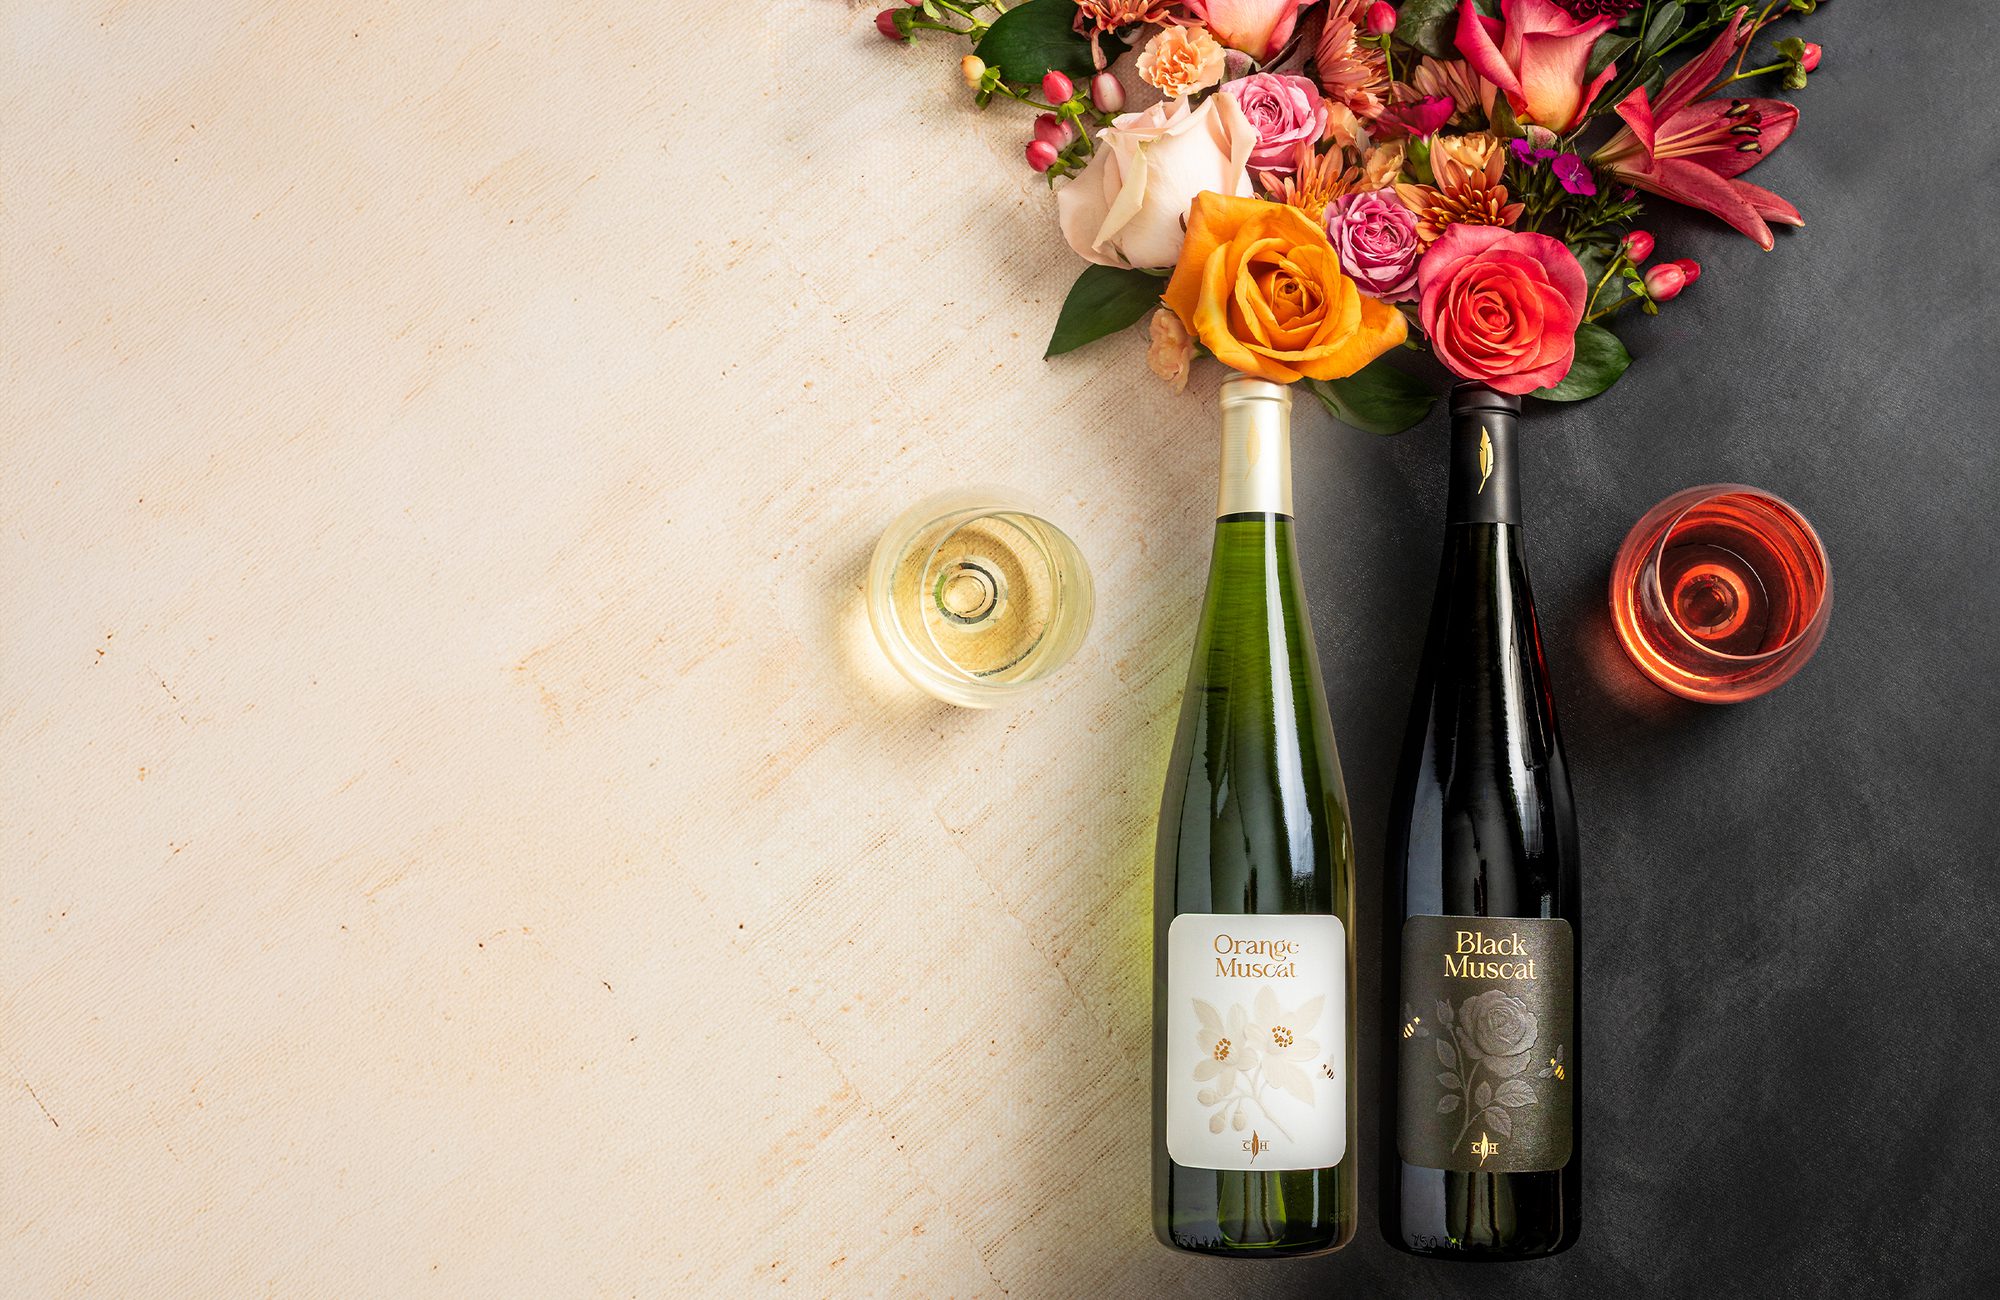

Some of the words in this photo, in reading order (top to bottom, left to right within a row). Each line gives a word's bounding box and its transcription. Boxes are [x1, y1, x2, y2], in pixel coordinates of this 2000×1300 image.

[1214, 933, 1299, 962] Orange
[1455, 930, 1528, 956] Black
[1215, 957, 1297, 978] Muscat
[1444, 954, 1538, 980] Muscat
